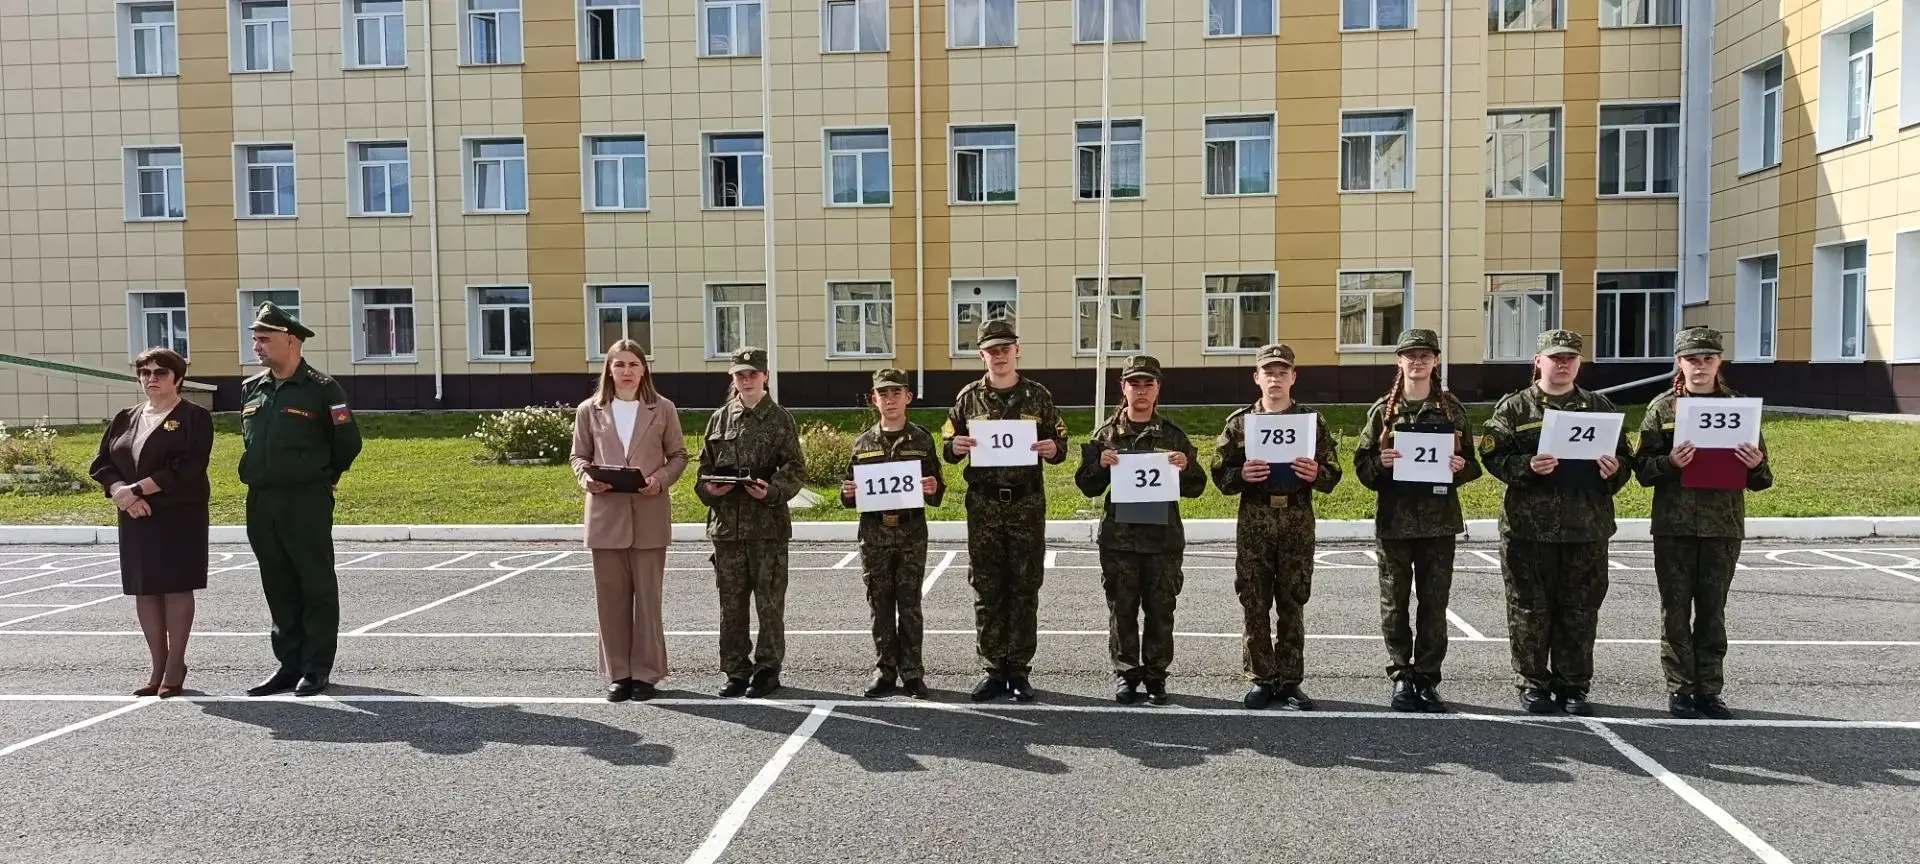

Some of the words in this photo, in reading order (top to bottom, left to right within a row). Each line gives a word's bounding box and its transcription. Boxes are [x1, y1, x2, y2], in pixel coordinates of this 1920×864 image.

[1699, 413, 1741, 429] 333
[991, 433, 1014, 449] 10
[1260, 429, 1296, 445] 783
[1568, 426, 1595, 442] 24
[1413, 446, 1438, 463] 21
[866, 475, 915, 496] 1128
[1135, 468, 1161, 489] 32
